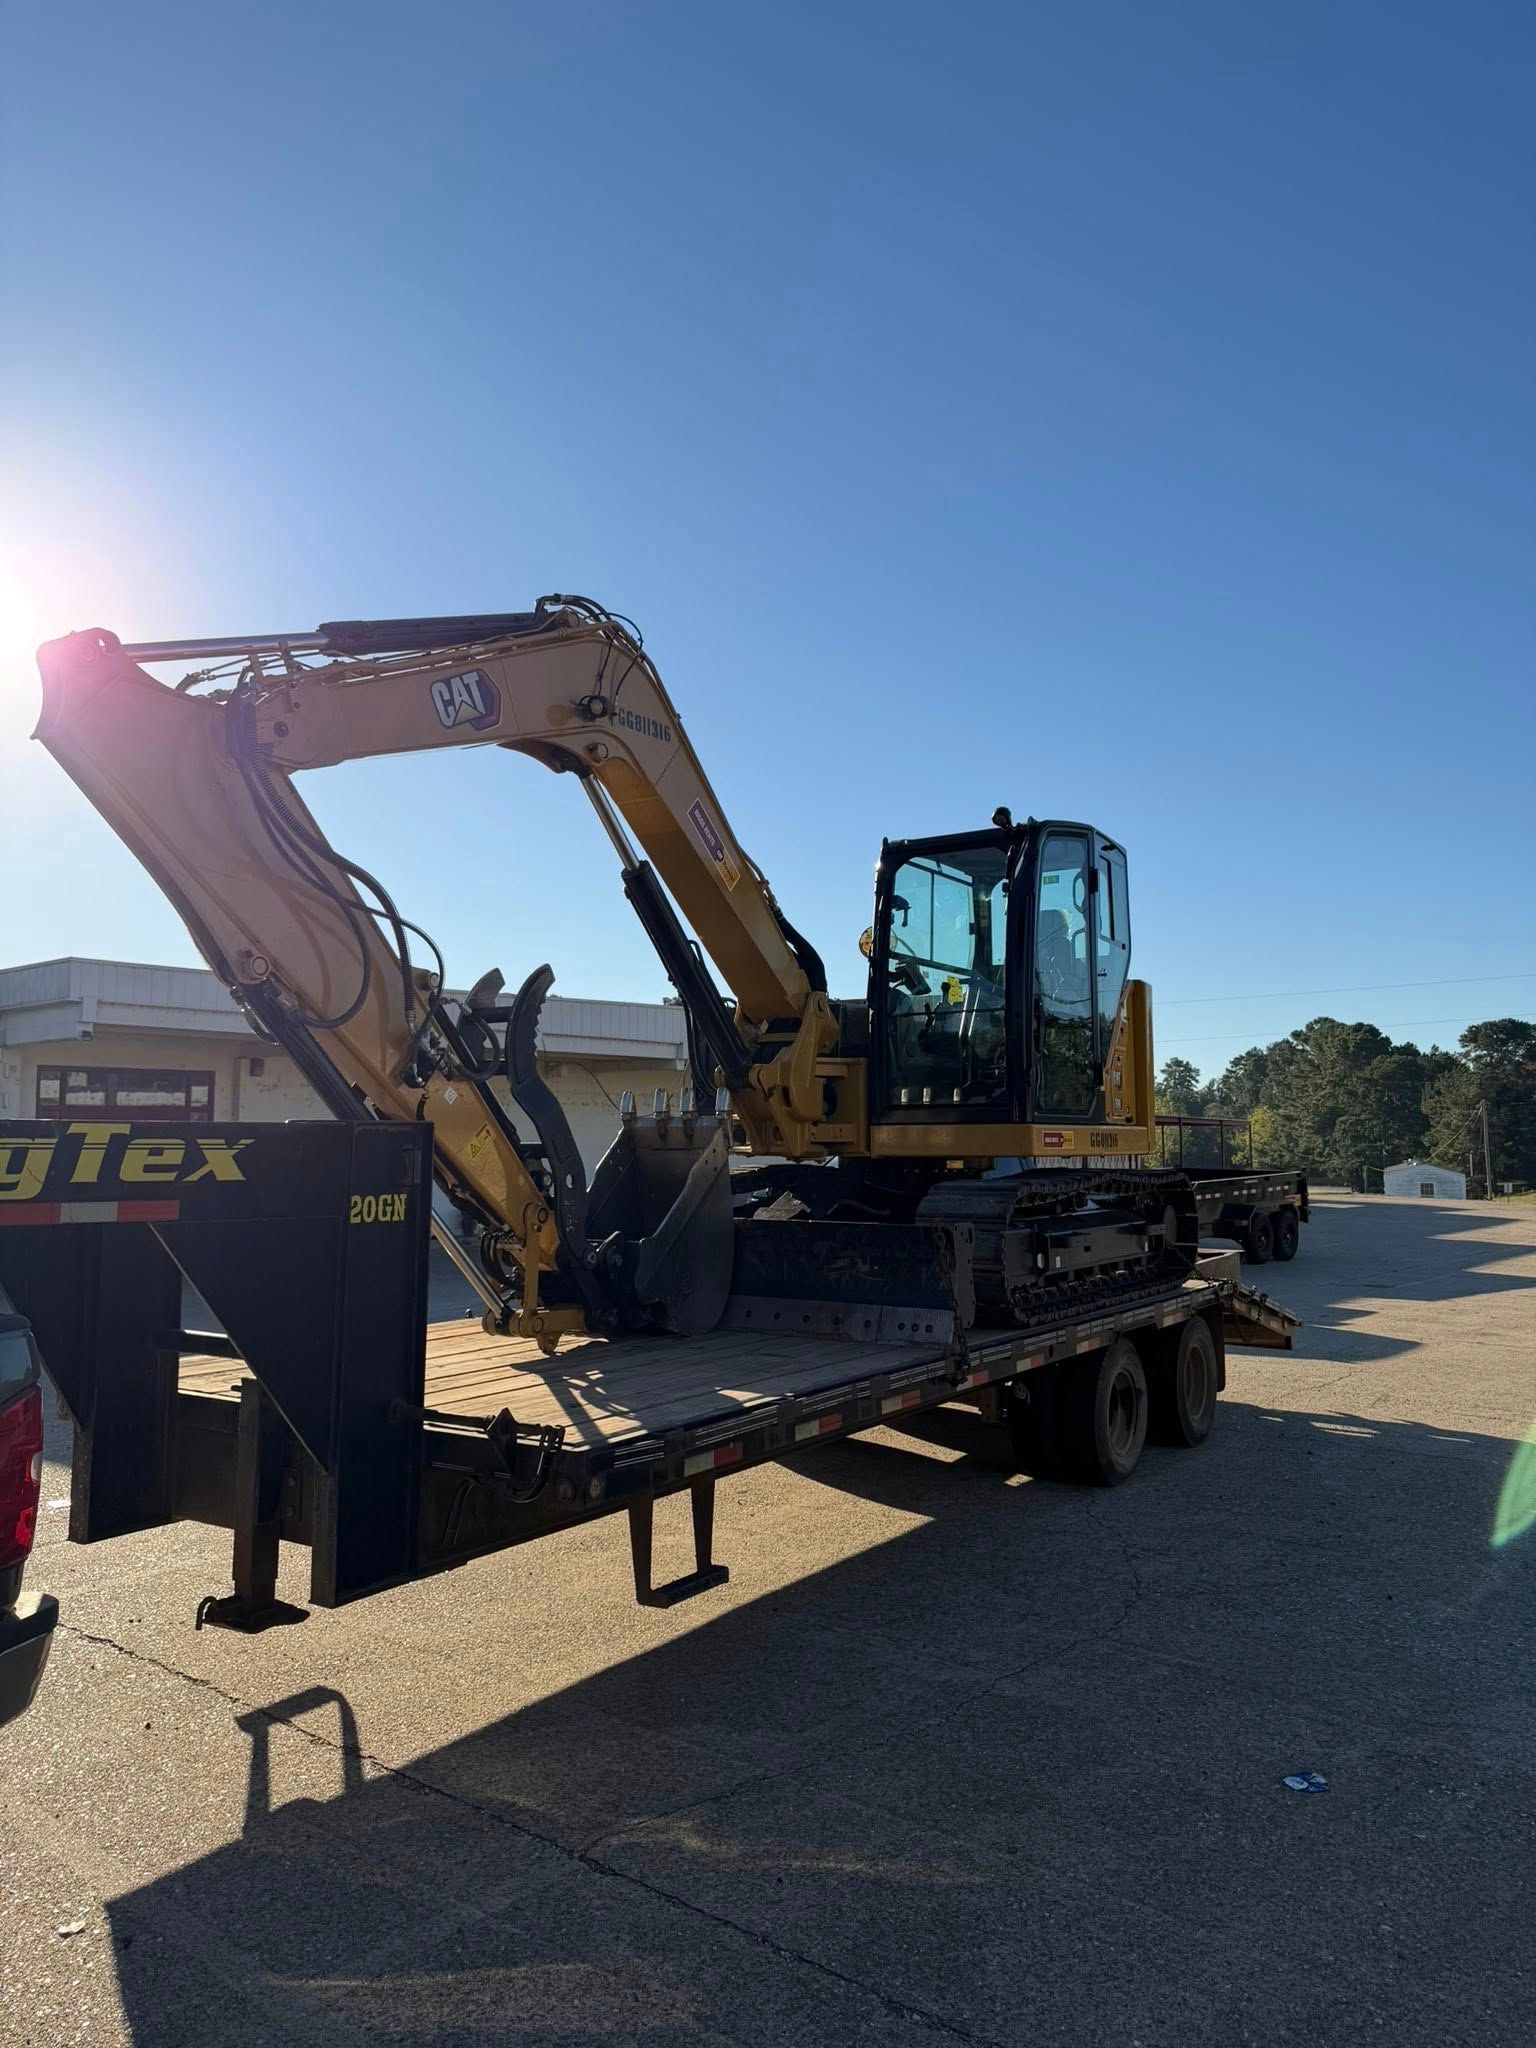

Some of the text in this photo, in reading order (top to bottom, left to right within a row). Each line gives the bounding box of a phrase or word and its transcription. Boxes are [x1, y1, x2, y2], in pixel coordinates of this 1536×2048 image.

[431, 671, 486, 727] CAT
[617, 708, 672, 742] GG811316
[350, 1193, 407, 1224] 20GN
